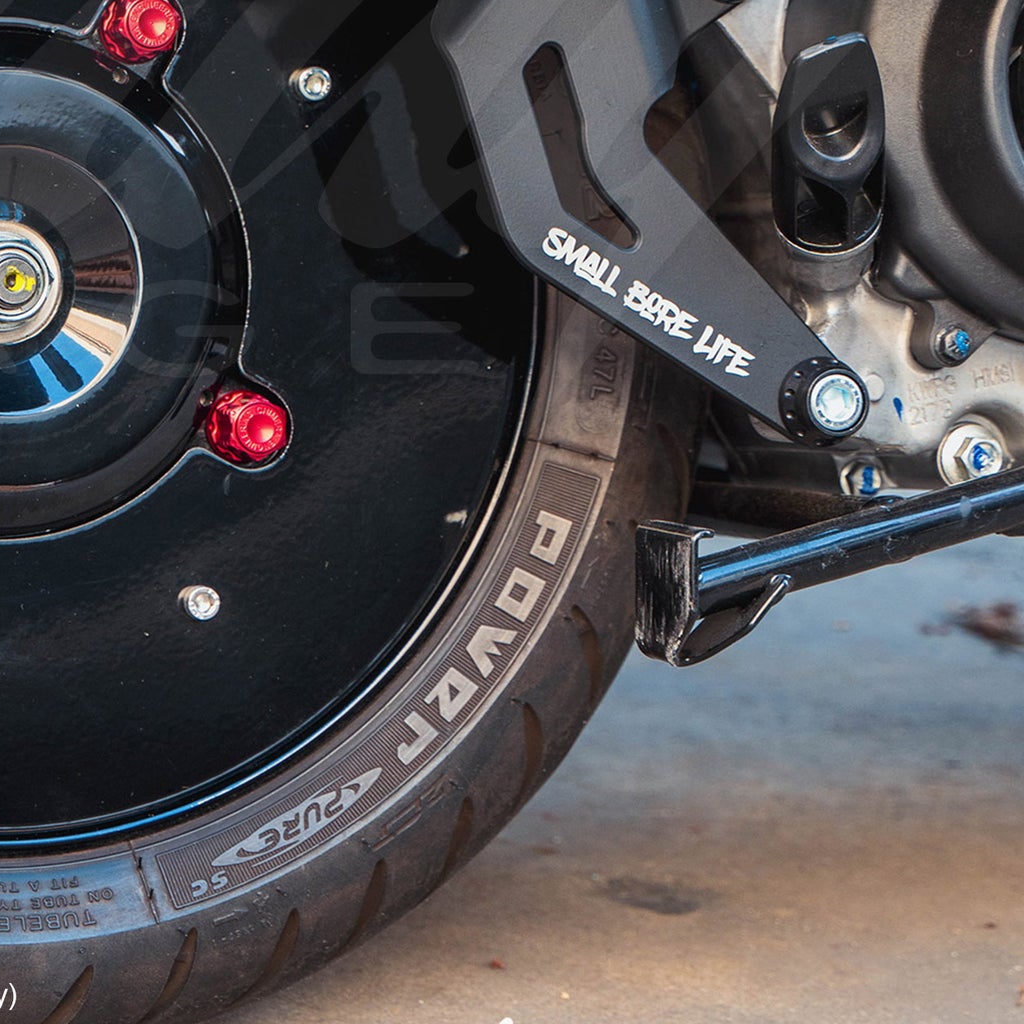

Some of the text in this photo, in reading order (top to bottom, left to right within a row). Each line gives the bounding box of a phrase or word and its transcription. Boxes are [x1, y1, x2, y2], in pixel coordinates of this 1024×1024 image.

[542, 226, 756, 377] SMALL BORE LIFE
[257, 785, 348, 849] PURE
[27, 879, 41, 893] A
[50, 875, 81, 891] FIT
[191, 870, 229, 898] SC
[30, 895, 81, 911] TUBE
[87, 887, 115, 904] ON
